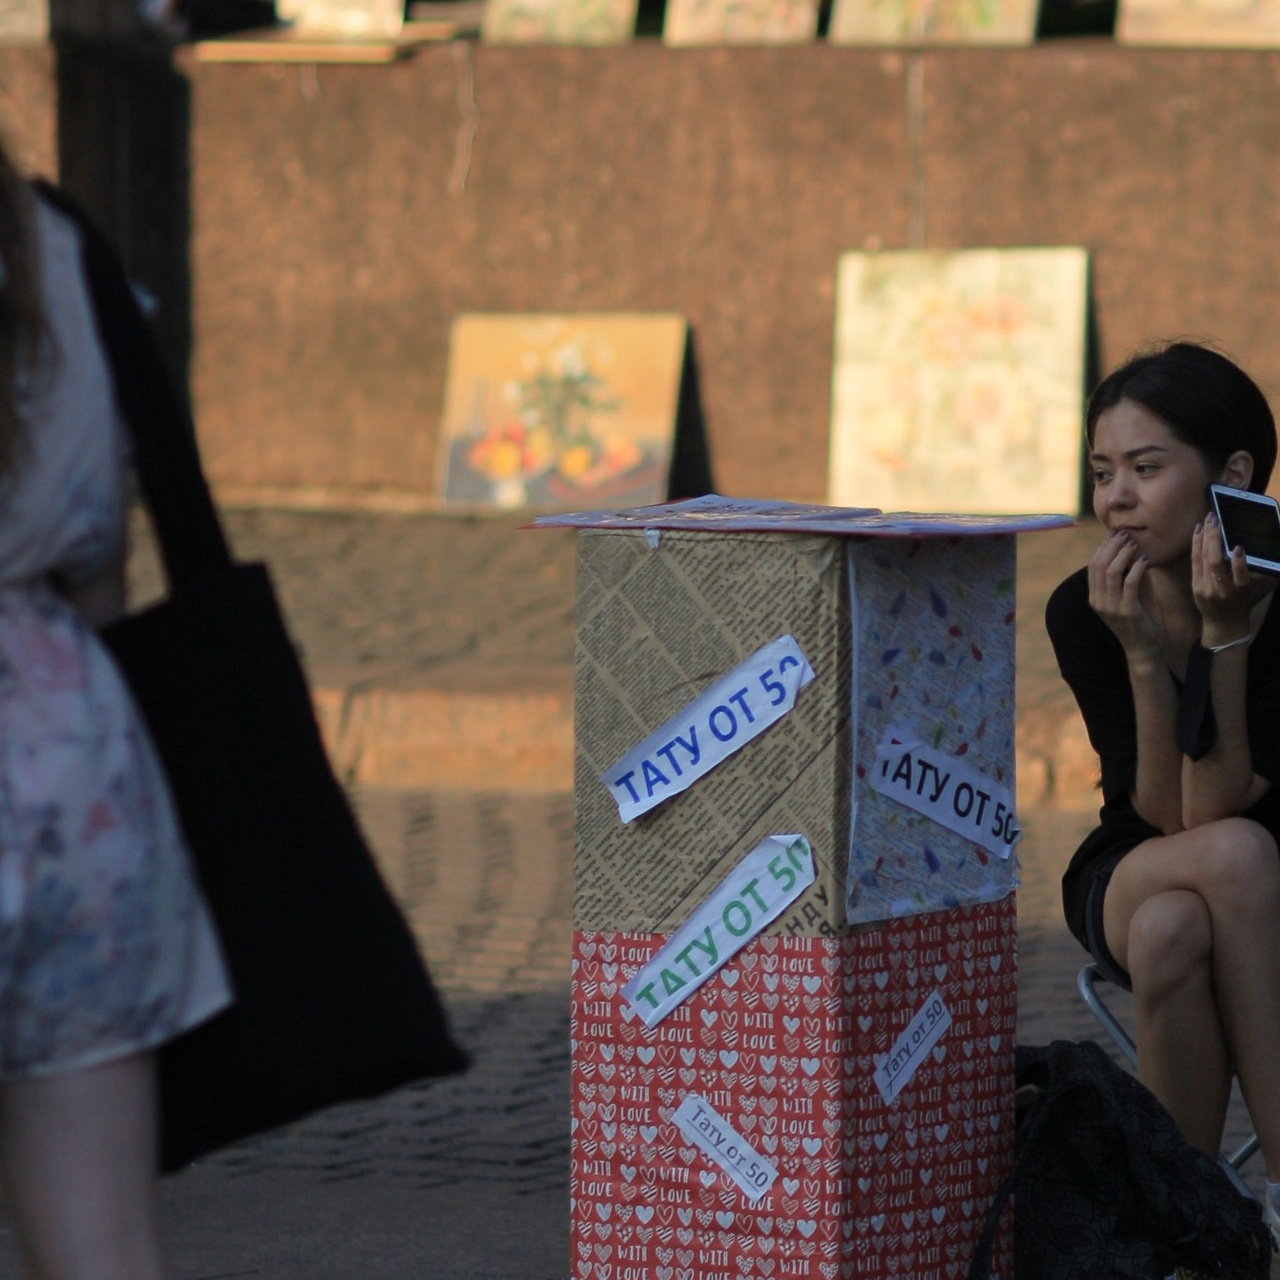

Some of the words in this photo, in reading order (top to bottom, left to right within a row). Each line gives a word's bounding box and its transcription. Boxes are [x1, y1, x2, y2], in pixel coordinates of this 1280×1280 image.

[614, 725, 700, 803] ТАТУ
[708, 686, 755, 742] ОТ
[954, 782, 991, 826] ОТ
[635, 926, 719, 1009] ТАТУ
[722, 878, 768, 937] ОТ
[783, 937, 812, 952] WITH
[782, 958, 814, 973] LOVE
[583, 1001, 611, 1017] WITH
[744, 1013, 774, 1028] WITH
[912, 1023, 927, 1043] от
[925, 1000, 942, 1025] 50
[583, 1022, 614, 1037] LOVE
[660, 1026, 693, 1042] LOVE
[743, 1035, 776, 1049] LOVE
[621, 1086, 649, 1102] WITH
[783, 1098, 813, 1114] WITH
[620, 1107, 651, 1123] LOVE
[782, 1119, 815, 1135] LOVE
[691, 1105, 727, 1147] Тату
[726, 1145, 746, 1166] от
[745, 1162, 769, 1187] 50
[583, 1160, 611, 1176] WITH
[660, 1168, 689, 1183] WITH
[582, 1182, 613, 1196] LOVE
[660, 1188, 692, 1203] LOVE
[618, 1245, 647, 1261] WITH
[700, 1250, 729, 1266] WITH
[780, 1259, 809, 1275] WITH
